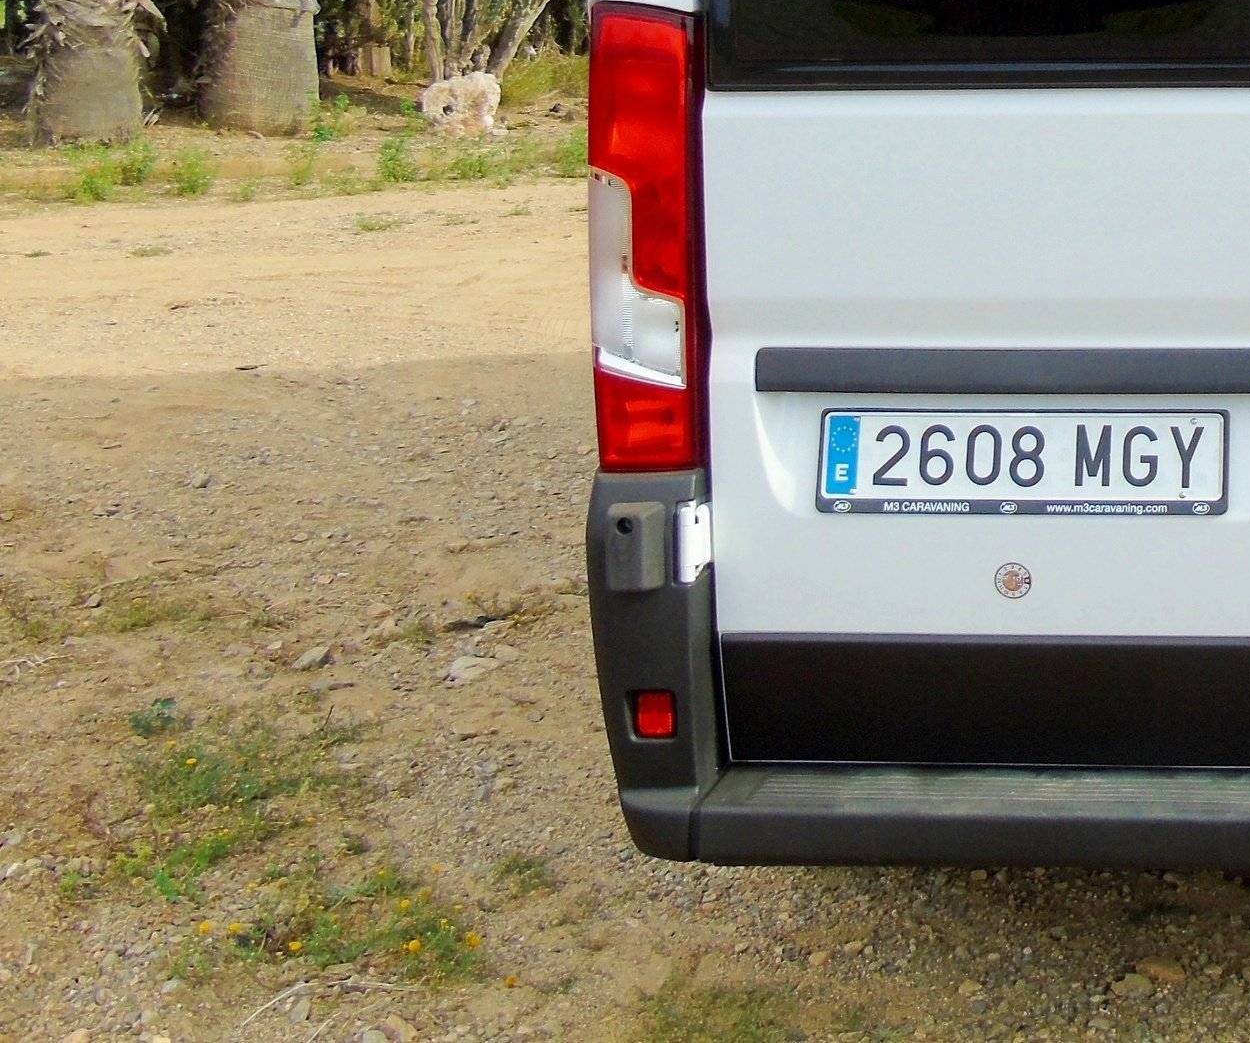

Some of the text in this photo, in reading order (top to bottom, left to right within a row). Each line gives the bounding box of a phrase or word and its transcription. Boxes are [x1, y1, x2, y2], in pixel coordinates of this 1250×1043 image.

[872, 424, 1204, 488] 2608 MGY
[835, 464, 849, 481] E
[883, 502, 970, 512] M3 CARAVANING
[1046, 503, 1168, 515] www.m3caravaning.com
